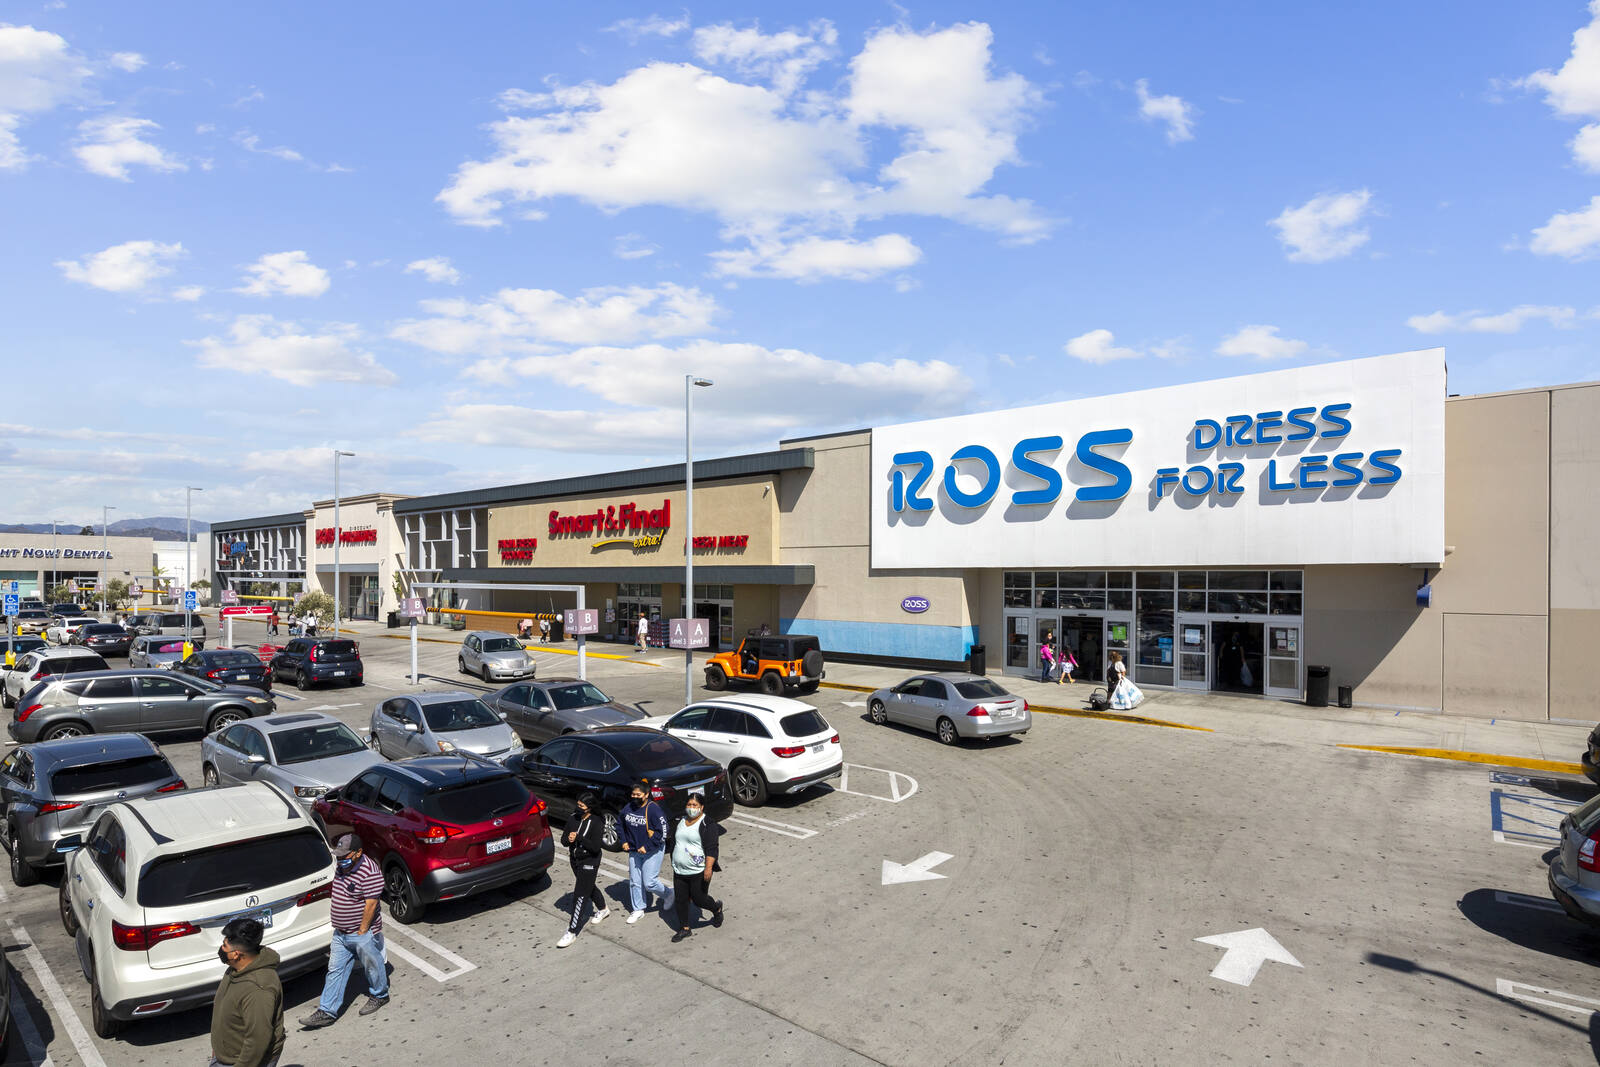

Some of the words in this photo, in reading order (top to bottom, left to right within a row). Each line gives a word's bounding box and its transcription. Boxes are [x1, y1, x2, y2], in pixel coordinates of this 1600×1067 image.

[1194, 403, 1352, 450] DRESS
[893, 428, 1134, 512] ROSS
[1156, 462, 1245, 498] FOR
[1268, 448, 1402, 490] LESS
[633, 529, 664, 548] extra!
[685, 536, 717, 548] RESH
[719, 535, 749, 547] MEAT
[904, 600, 927, 609] ROSS
[585, 613, 591, 624] B
[675, 623, 682, 635] A
[695, 623, 703, 635] A
[625, 814, 647, 825] BOBCATS
